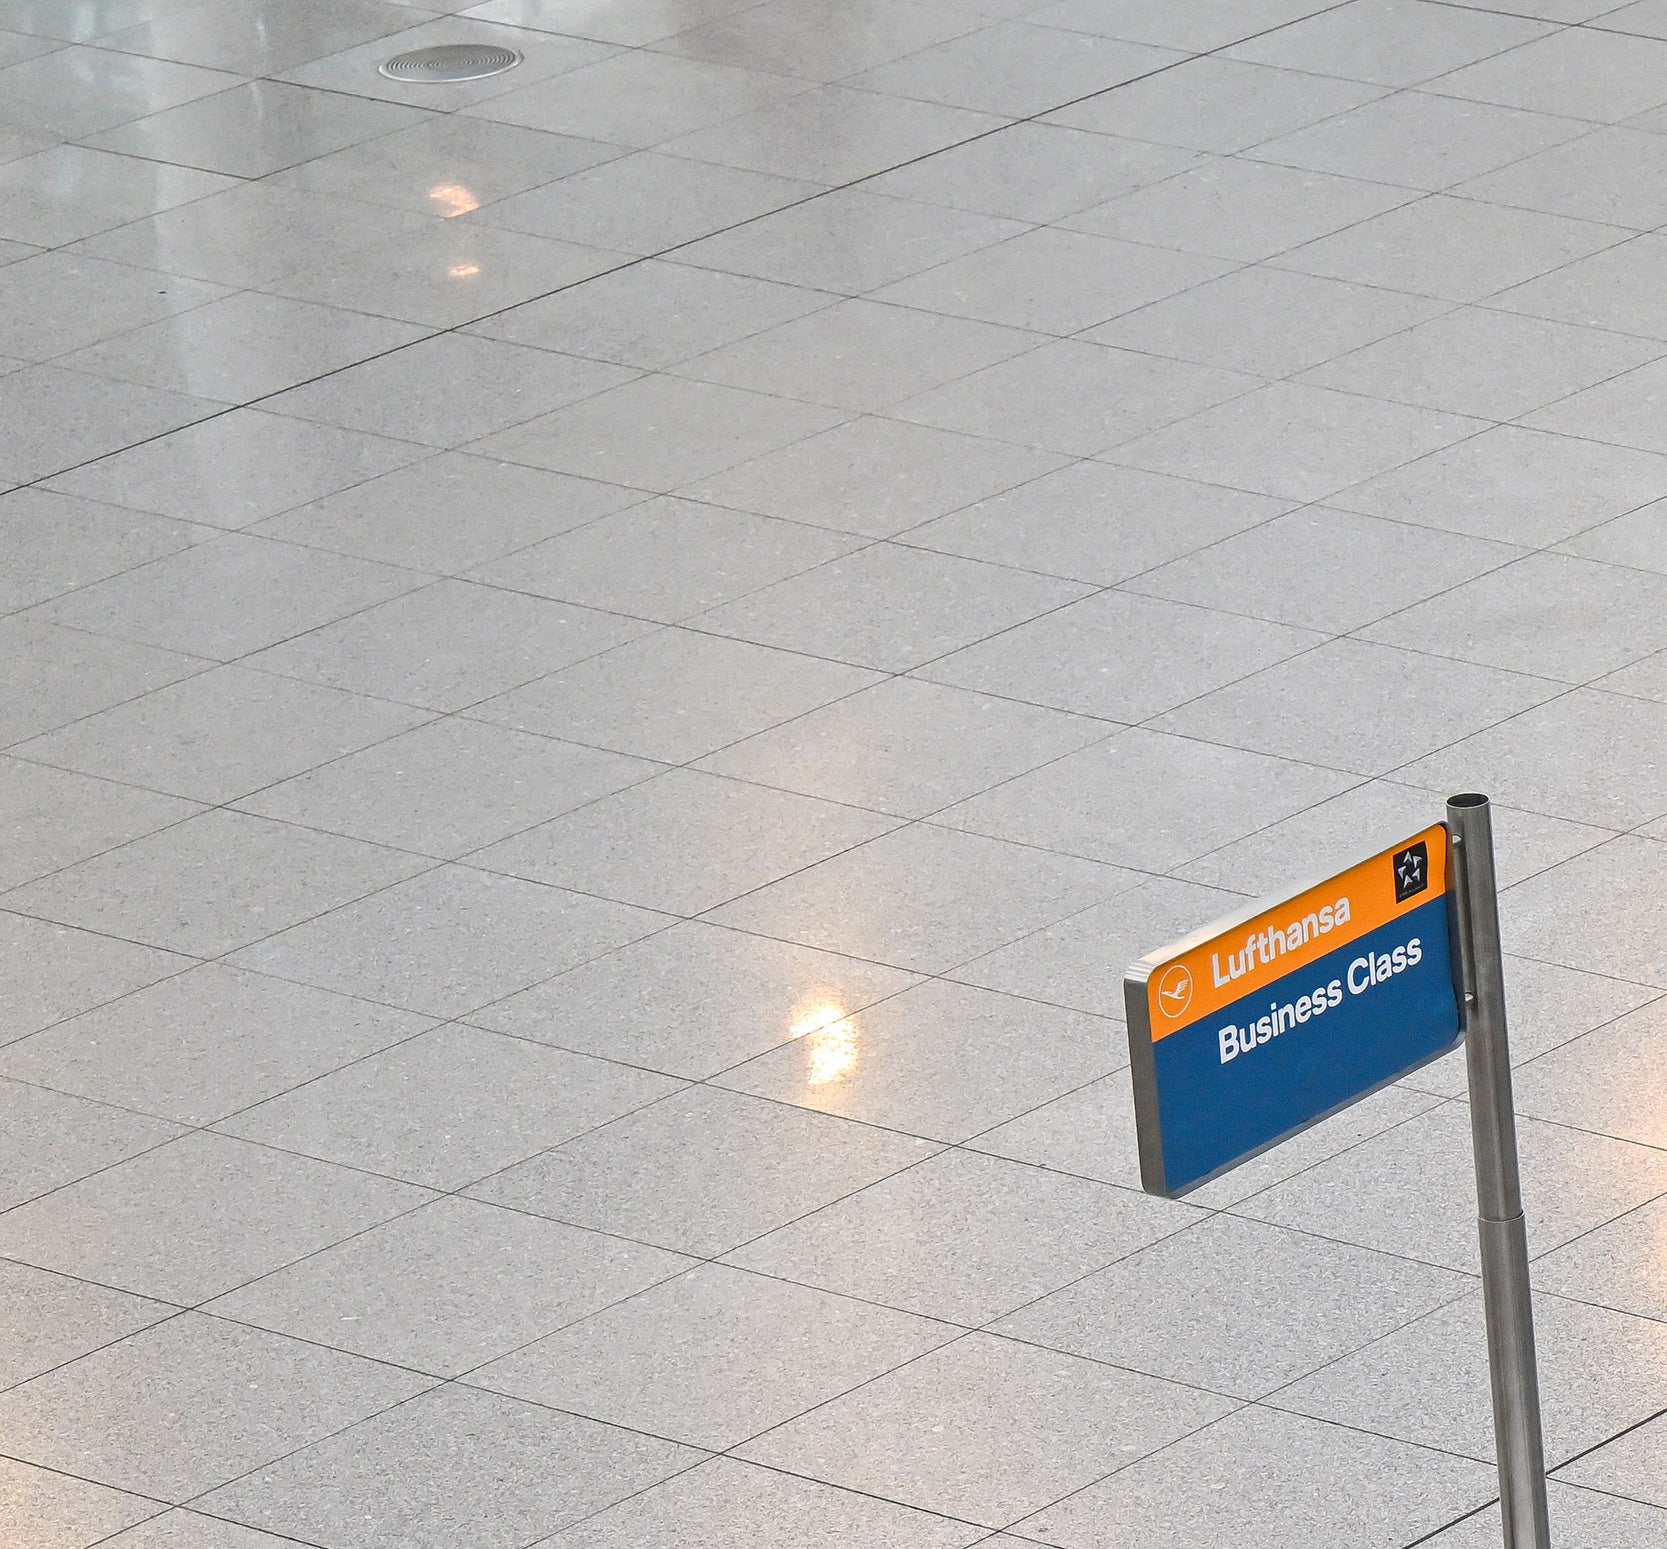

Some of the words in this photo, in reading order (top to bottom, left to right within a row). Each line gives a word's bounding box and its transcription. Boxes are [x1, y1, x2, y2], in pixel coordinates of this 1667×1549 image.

[1212, 897, 1351, 989] Lufthansa
[1217, 978, 1343, 1064] Business
[1346, 938, 1422, 995] Class
